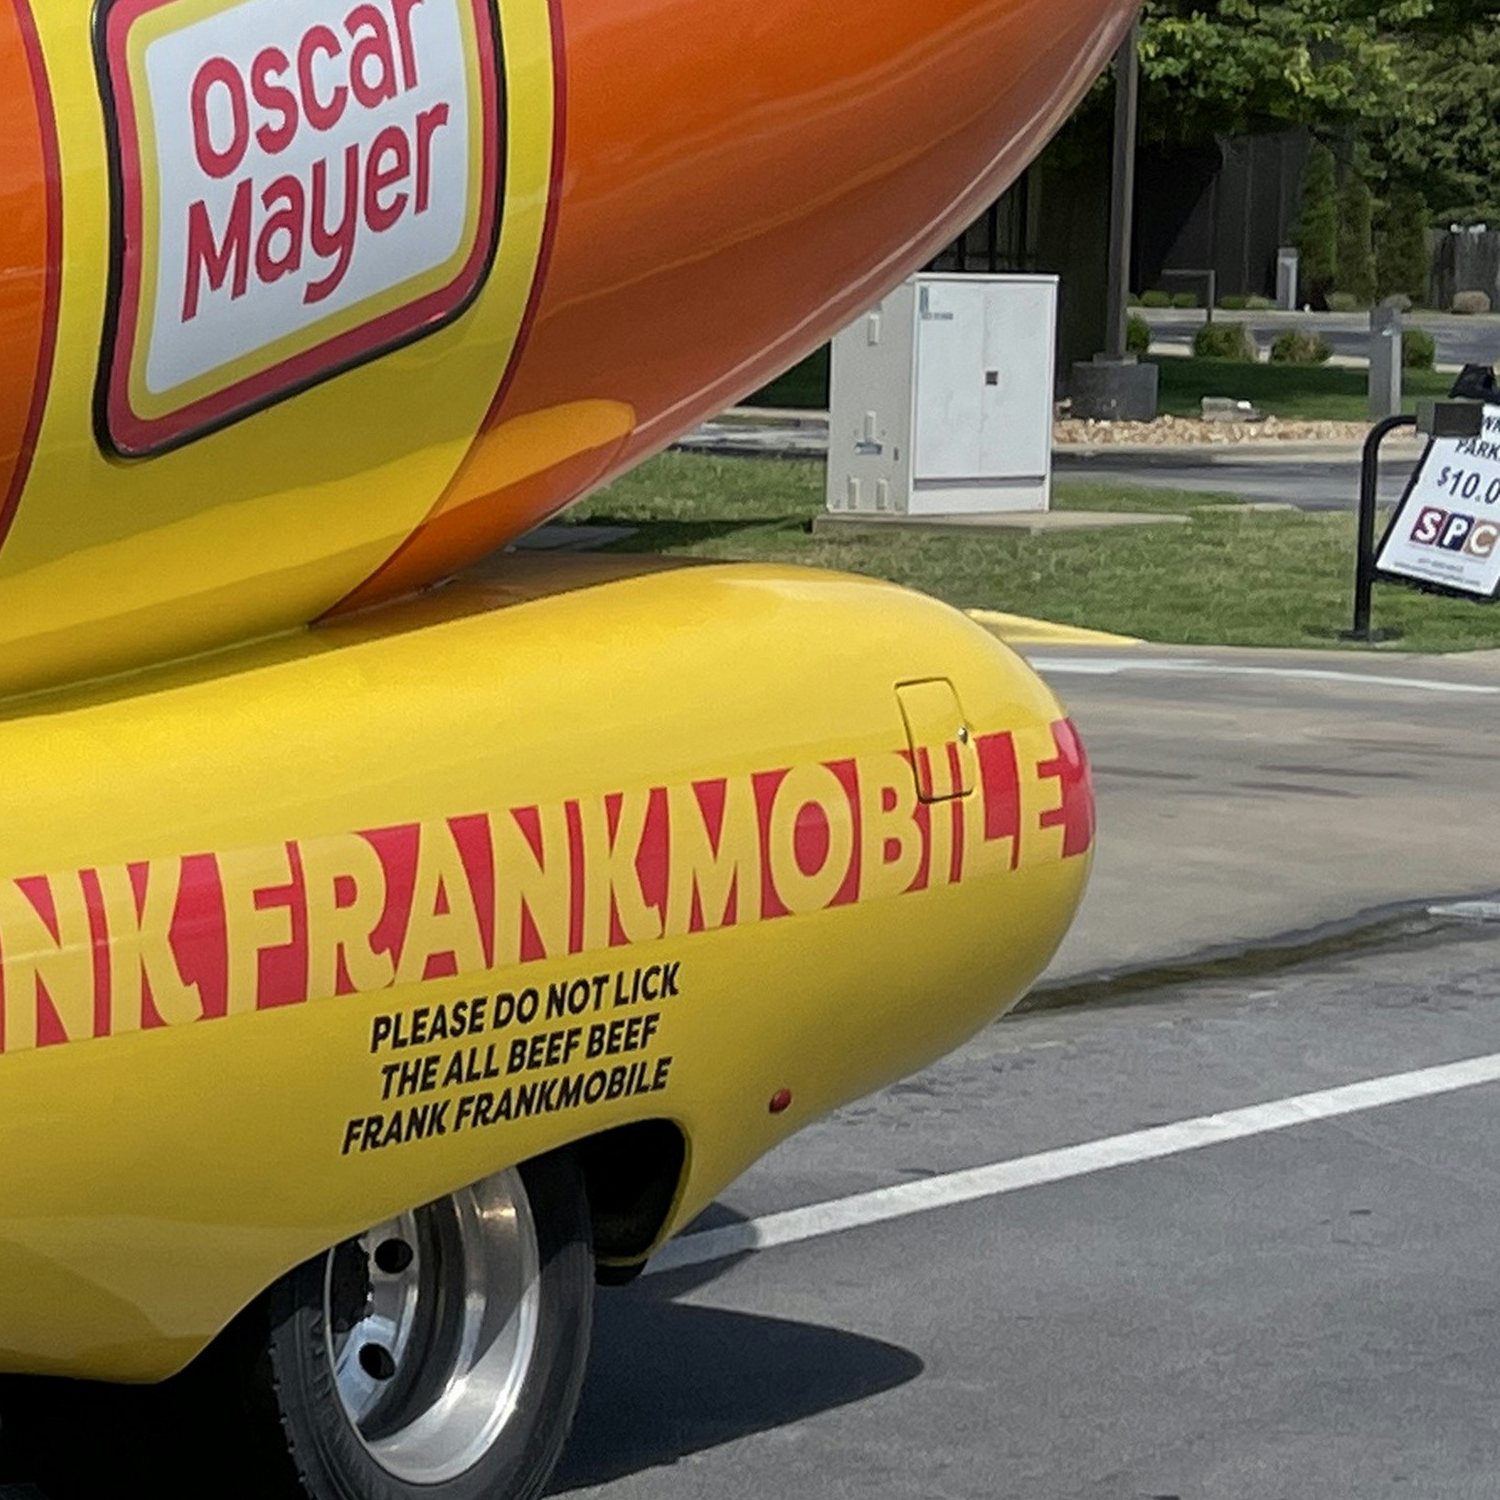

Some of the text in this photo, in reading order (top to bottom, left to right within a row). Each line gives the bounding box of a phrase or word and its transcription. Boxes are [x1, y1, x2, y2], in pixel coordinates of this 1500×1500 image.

[181, 102, 449, 323] Mayer
[1415, 510, 1498, 557] SPC
[214, 720, 1070, 1013] FRANKMOBILE
[370, 961, 681, 1053] PLEASE DO NOT LICK
[381, 1013, 660, 1100] THE ALL BEEF BEEF
[342, 1056, 673, 1154] FRANK FRANKMOBILE
